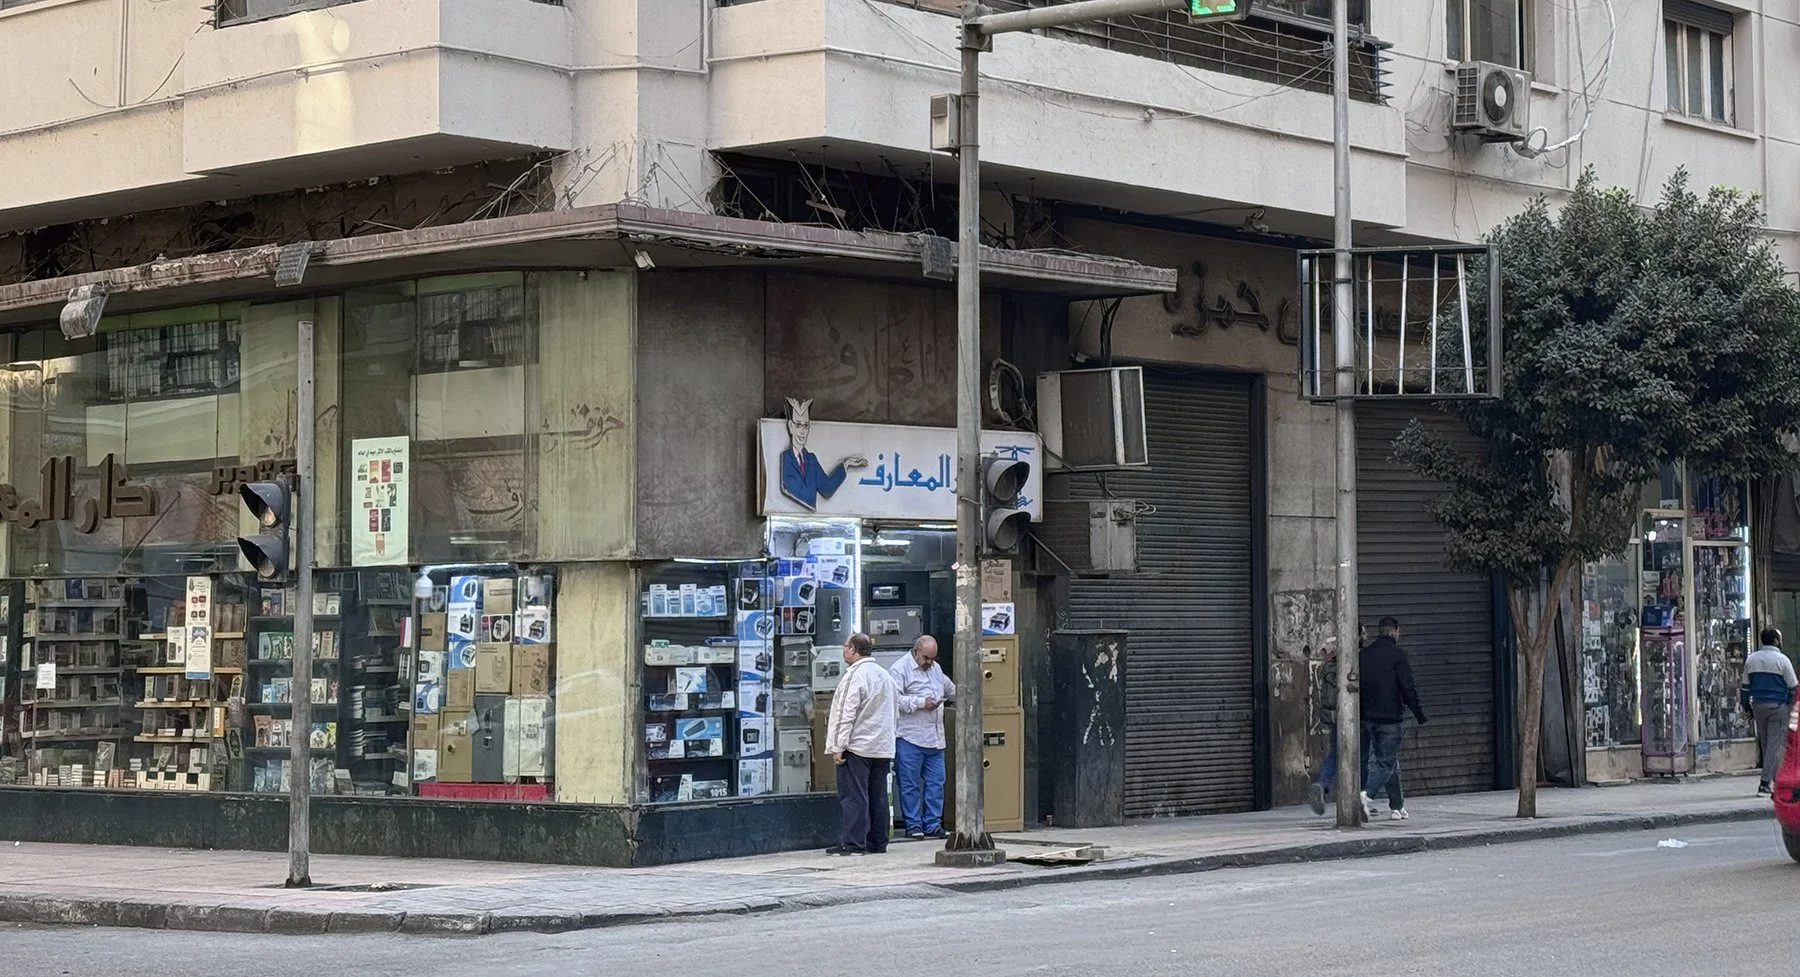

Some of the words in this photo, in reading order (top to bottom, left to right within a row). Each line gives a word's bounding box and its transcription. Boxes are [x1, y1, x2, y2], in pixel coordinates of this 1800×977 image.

[208, 458, 299, 496] كتوبر
[859, 451, 951, 492] المعارف
[79, 453, 157, 534] دار
